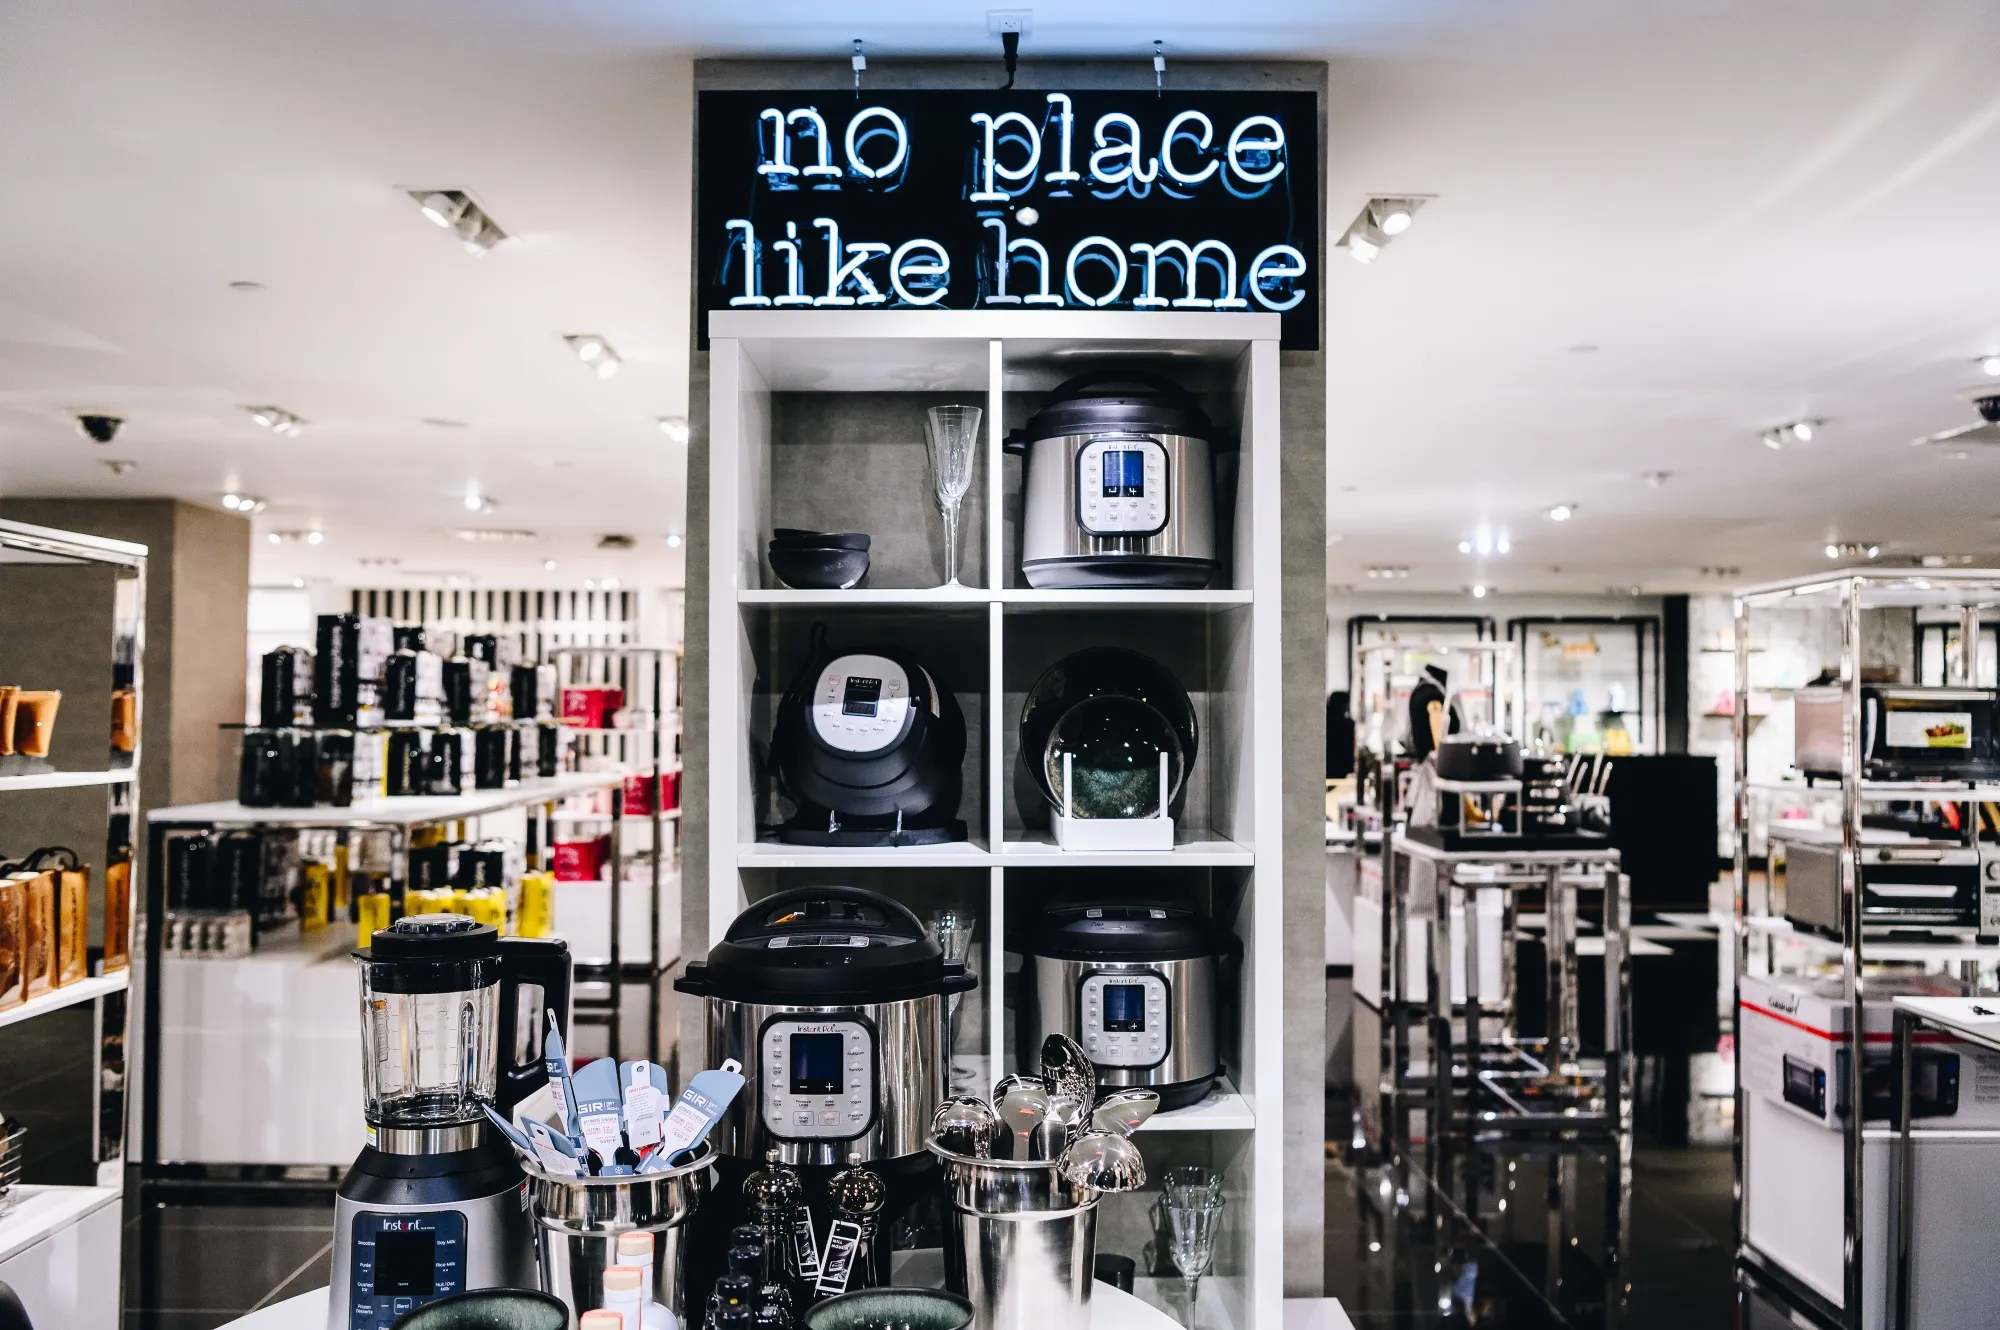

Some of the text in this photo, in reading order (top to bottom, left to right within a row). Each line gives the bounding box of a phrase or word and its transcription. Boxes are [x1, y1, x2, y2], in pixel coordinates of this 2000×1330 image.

[759, 94, 1284, 201] no place
[727, 216, 1306, 311] like home
[683, 1089, 706, 1107] GIR
[578, 1102, 603, 1114] GIR
[383, 1219, 420, 1230] Instant
